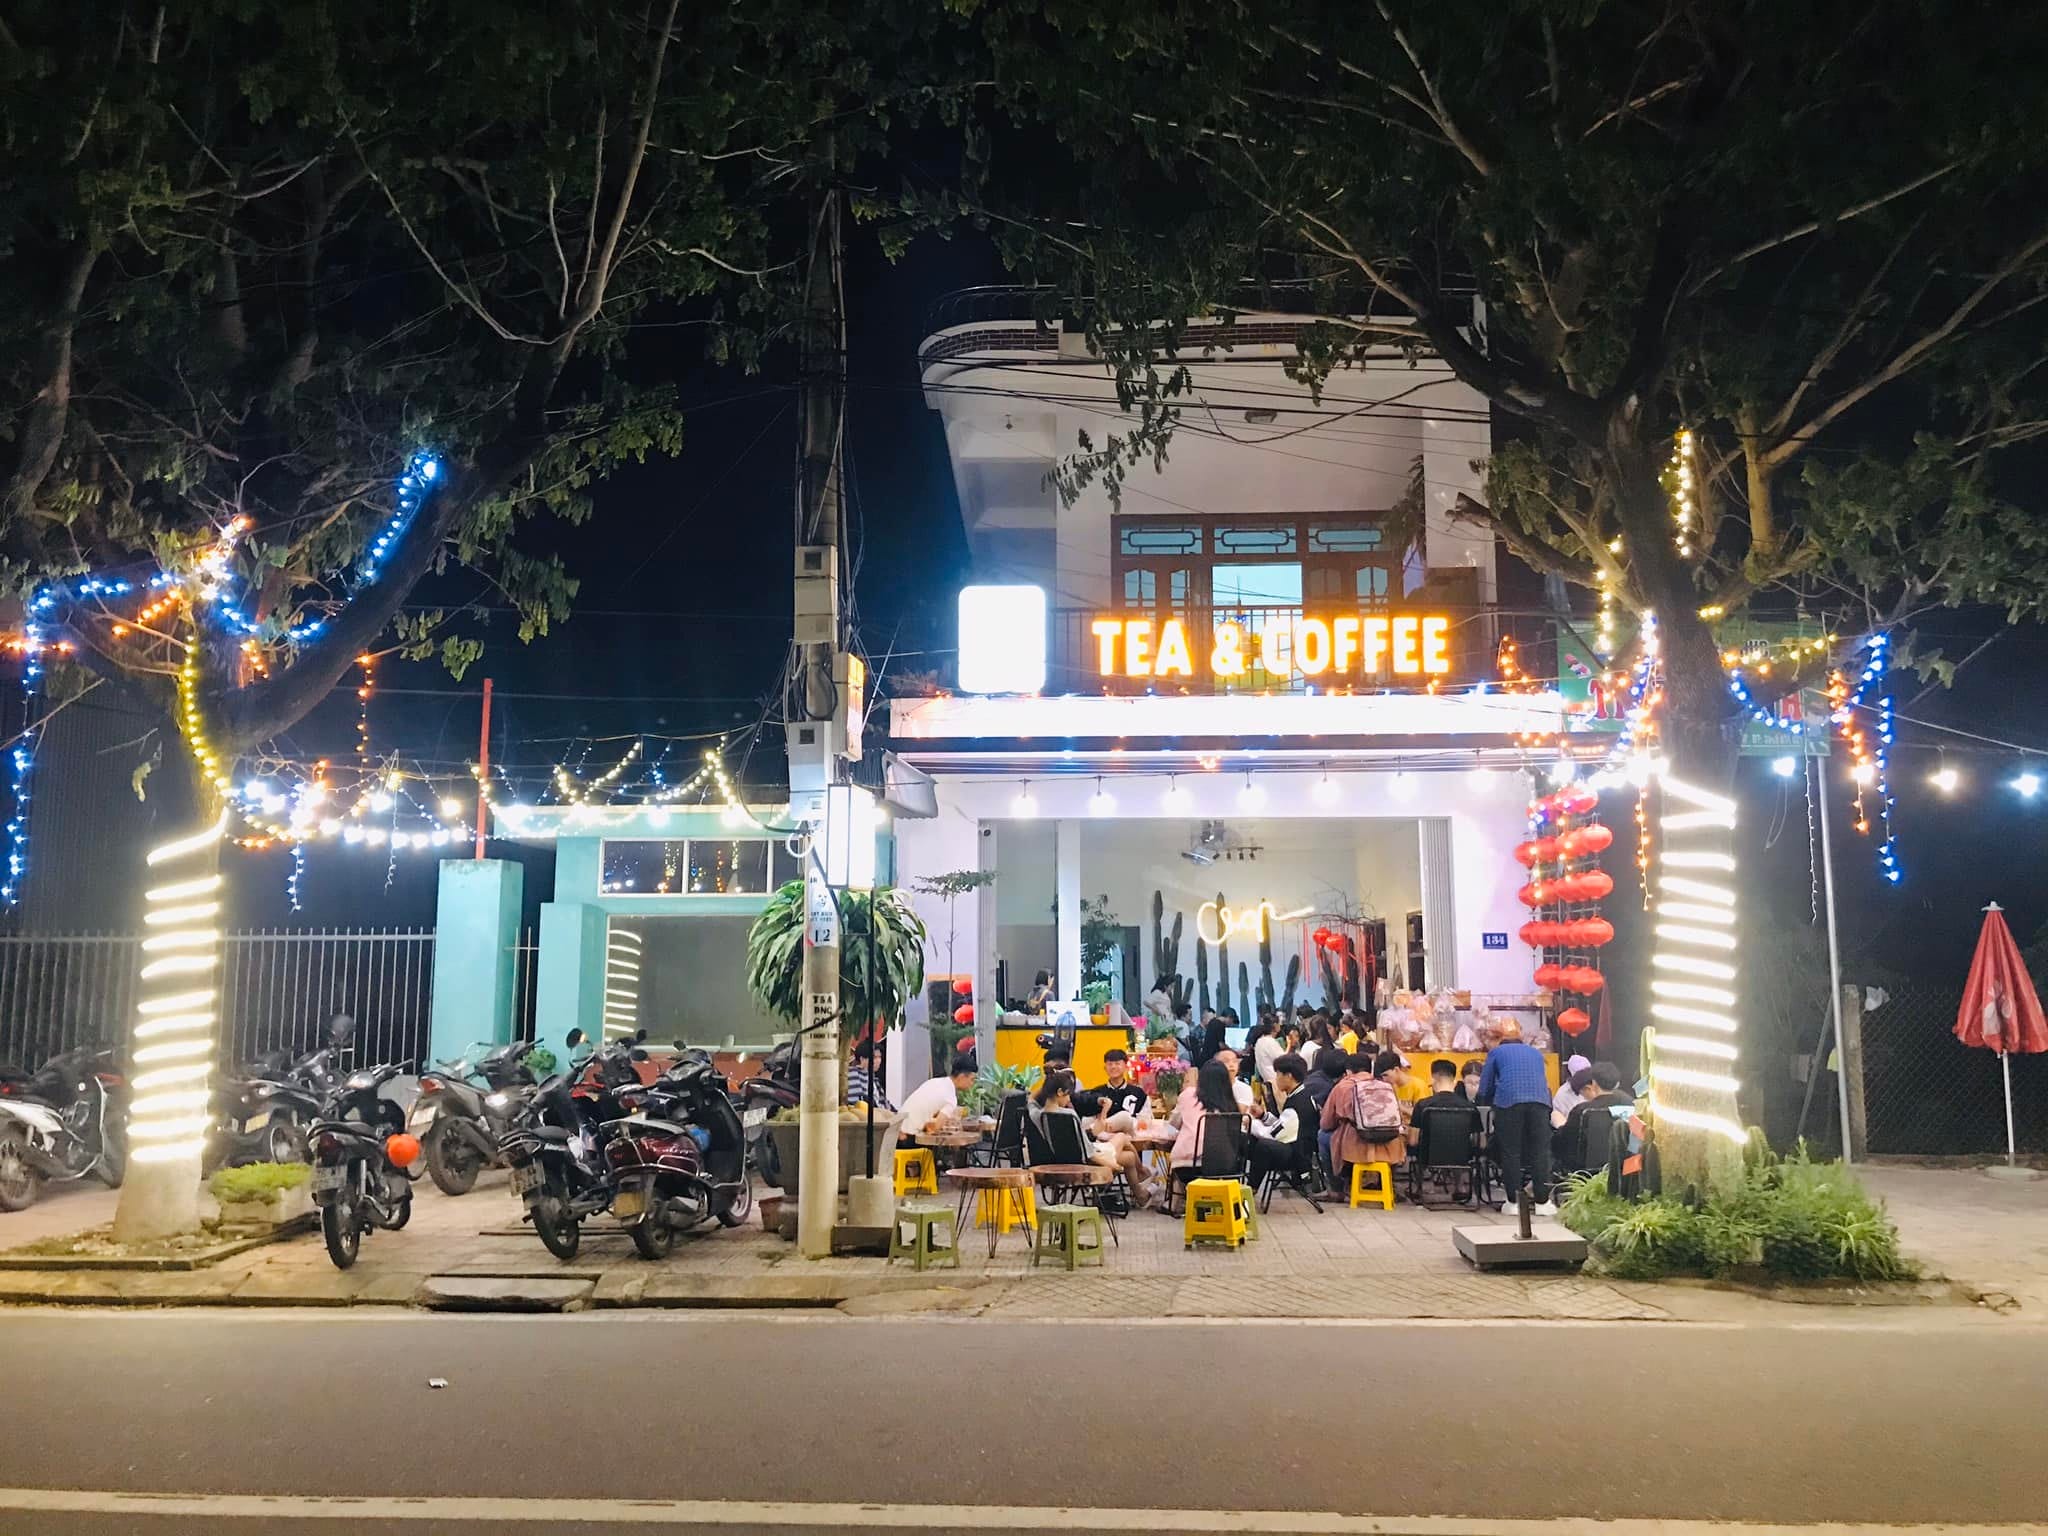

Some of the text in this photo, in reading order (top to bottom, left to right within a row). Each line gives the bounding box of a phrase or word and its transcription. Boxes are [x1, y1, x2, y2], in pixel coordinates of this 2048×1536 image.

[1091, 616, 1450, 677] TEA & COFFEE
